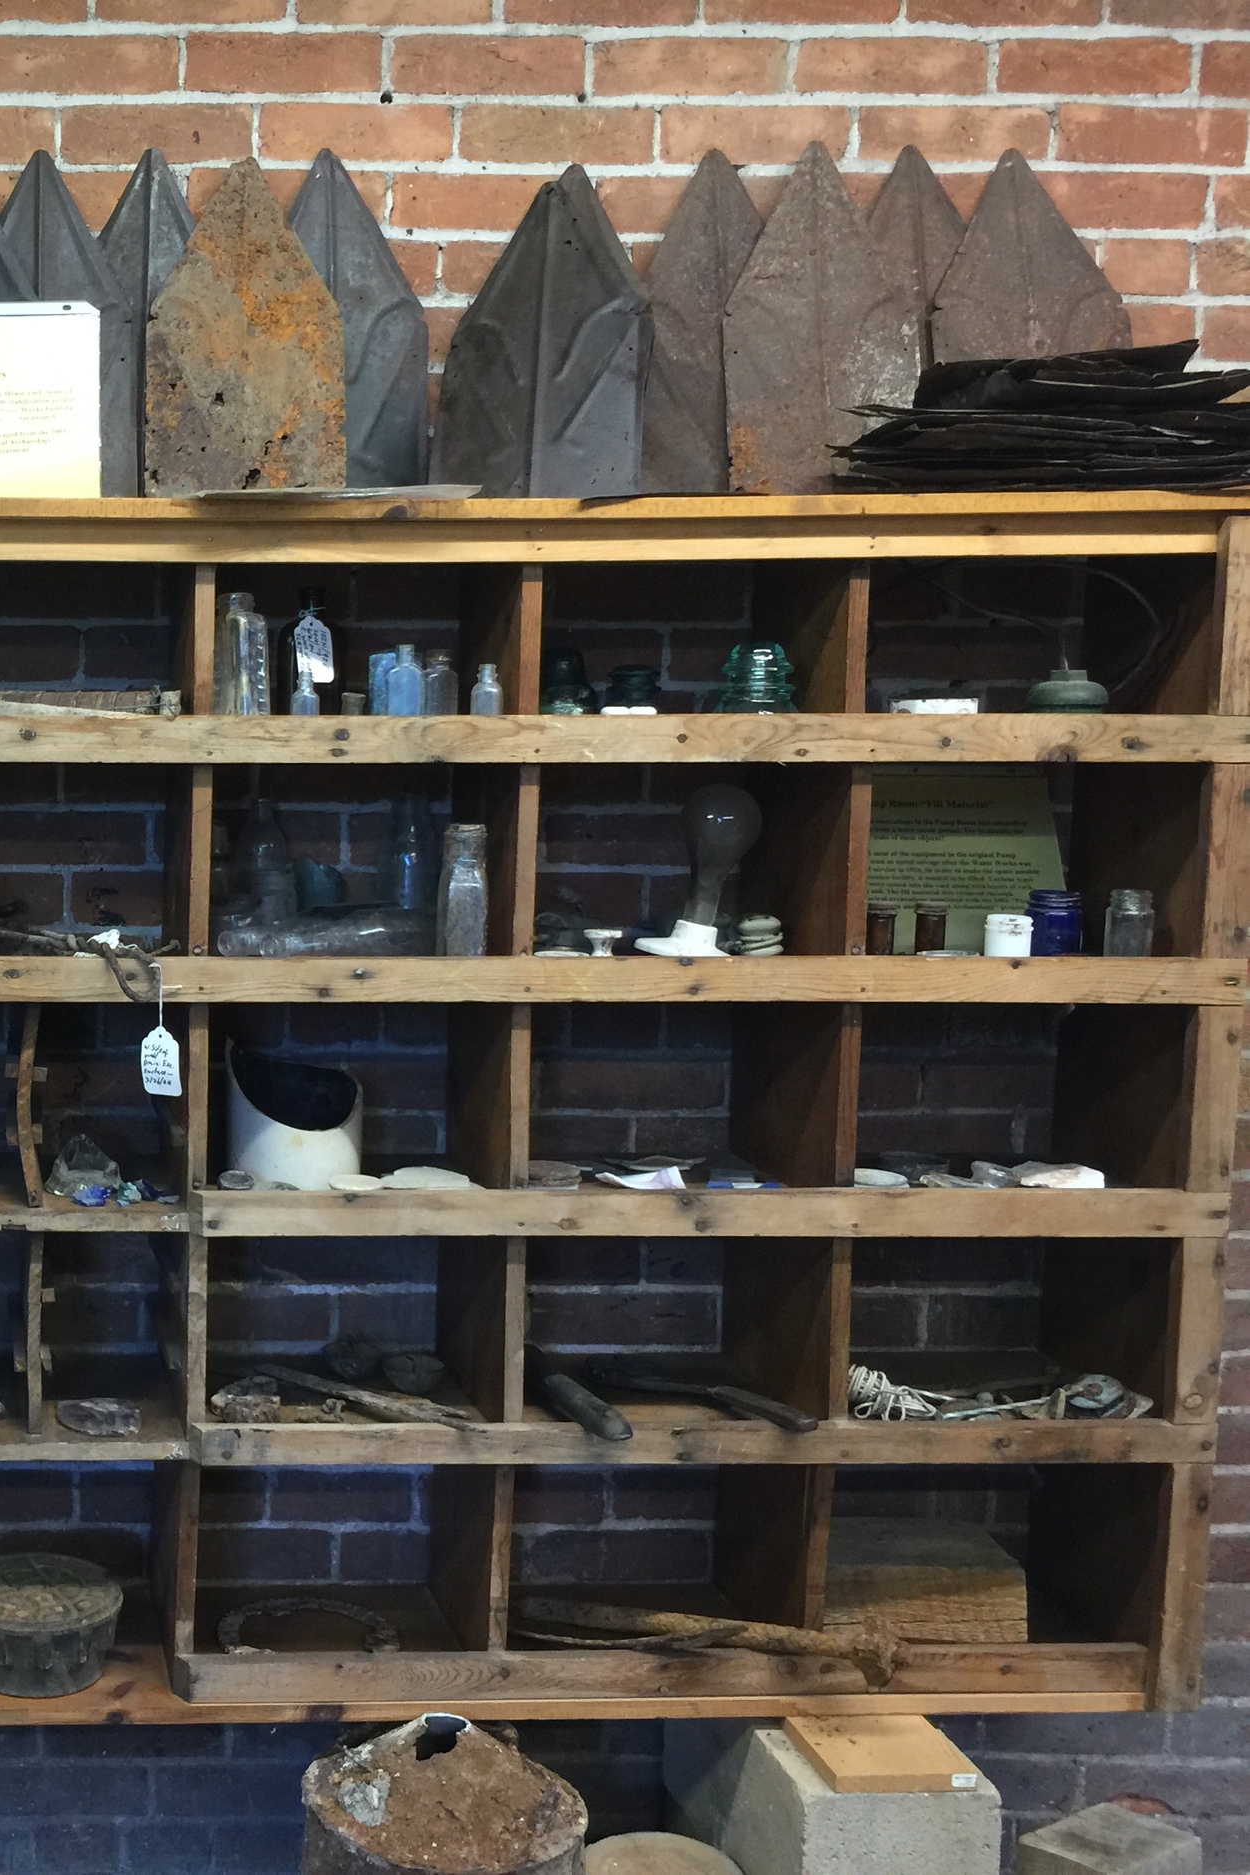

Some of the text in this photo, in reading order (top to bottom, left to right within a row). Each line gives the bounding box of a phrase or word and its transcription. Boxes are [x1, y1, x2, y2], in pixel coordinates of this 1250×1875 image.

[888, 799, 918, 809] Room
[910, 851, 946, 859] equipment
[968, 851, 995, 860] original
[995, 852, 1017, 860] Pump
[970, 859, 993, 867] Water
[993, 859, 1018, 867] Works
